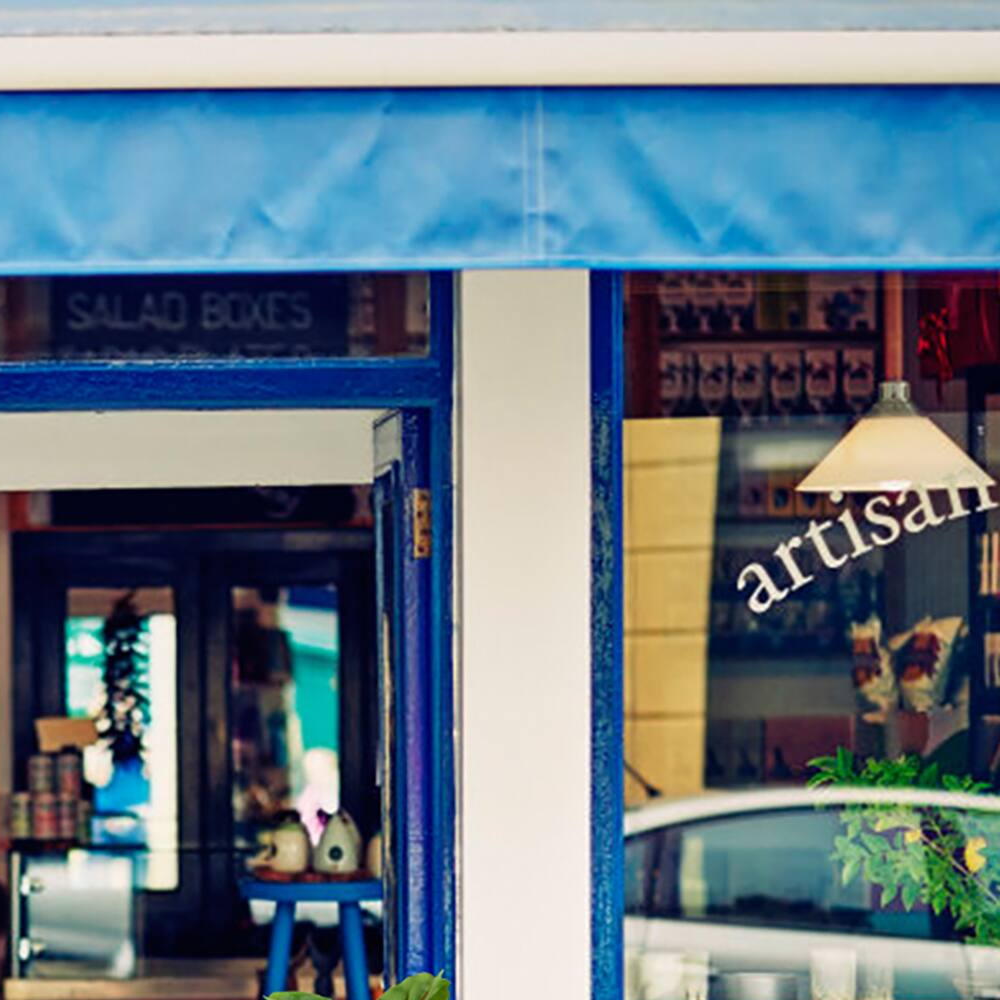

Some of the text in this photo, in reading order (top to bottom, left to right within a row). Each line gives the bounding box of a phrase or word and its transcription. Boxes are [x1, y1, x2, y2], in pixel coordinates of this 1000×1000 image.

[66, 290, 313, 331] SALAD BOXES
[736, 467, 1000, 615] artisan
